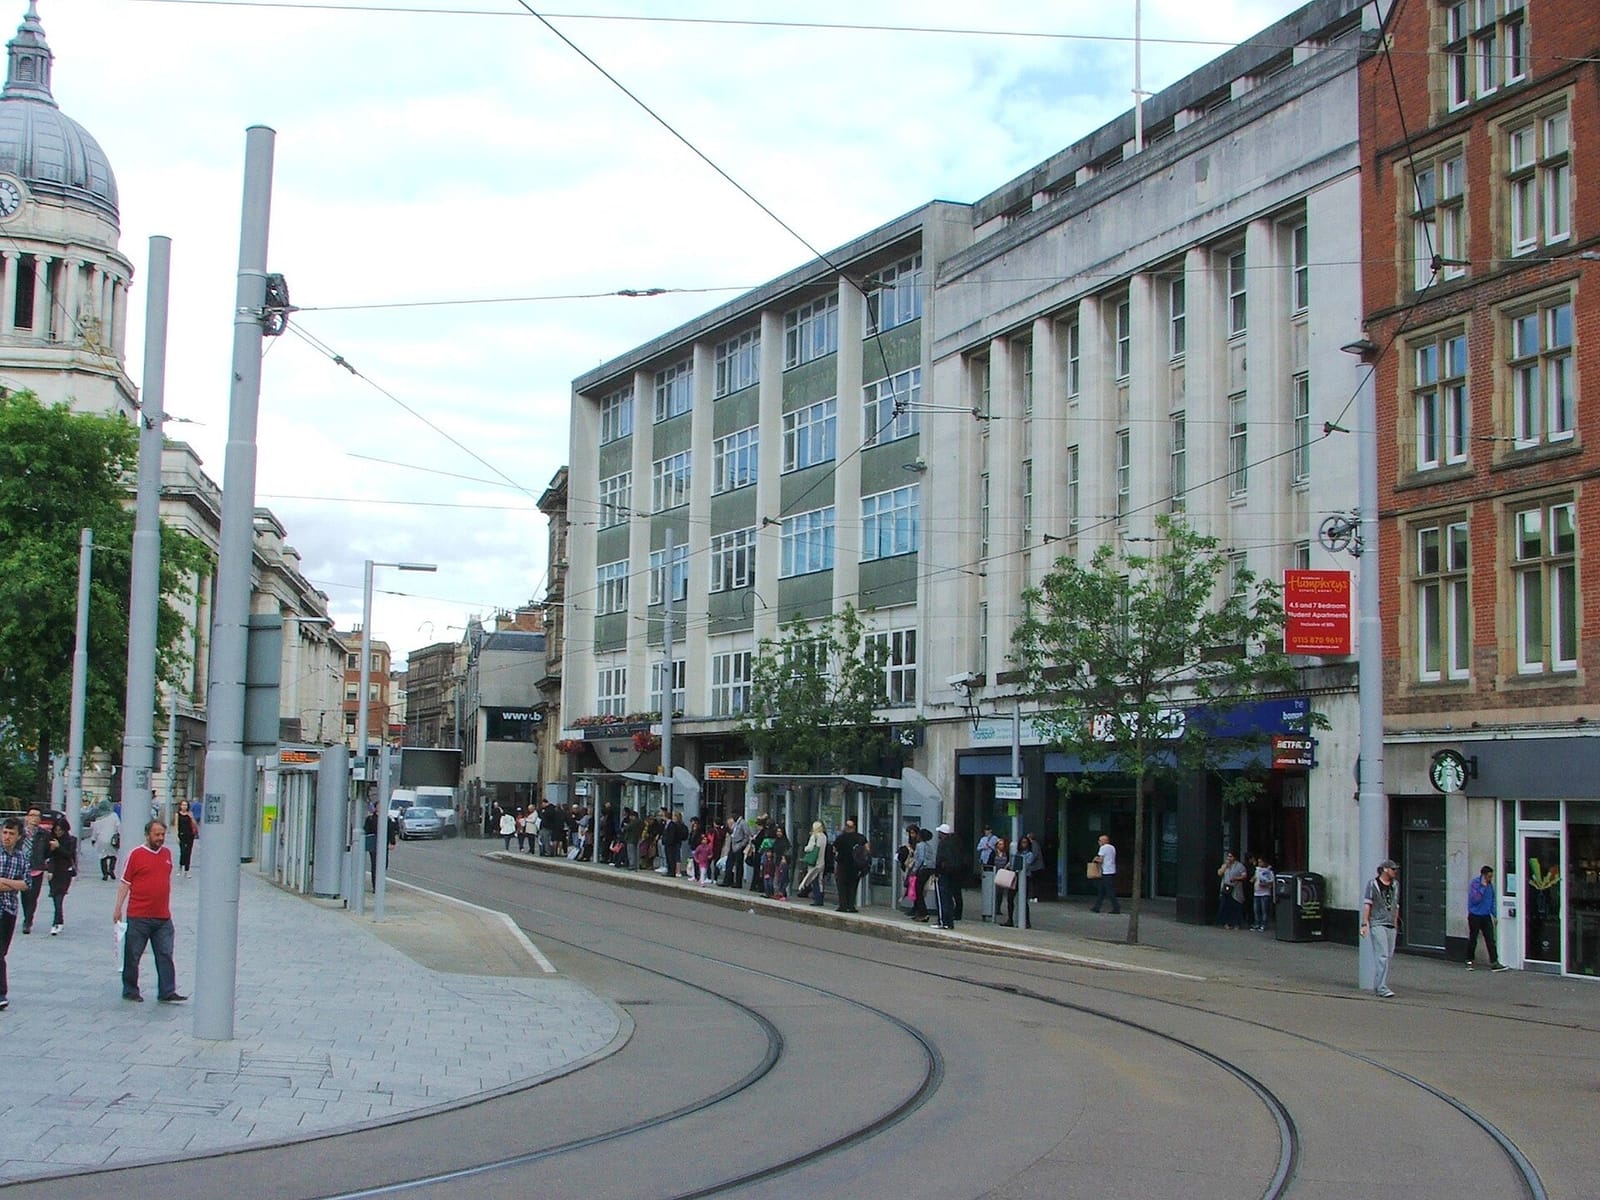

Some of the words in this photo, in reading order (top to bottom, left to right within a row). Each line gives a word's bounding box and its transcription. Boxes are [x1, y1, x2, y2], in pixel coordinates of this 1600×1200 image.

[1288, 576, 1348, 593] Humphreys
[1312, 611, 1349, 619] Apartments
[1292, 636, 1309, 644] 0115
[1277, 740, 1312, 750] BETFRD
[1298, 757, 1312, 766] king
